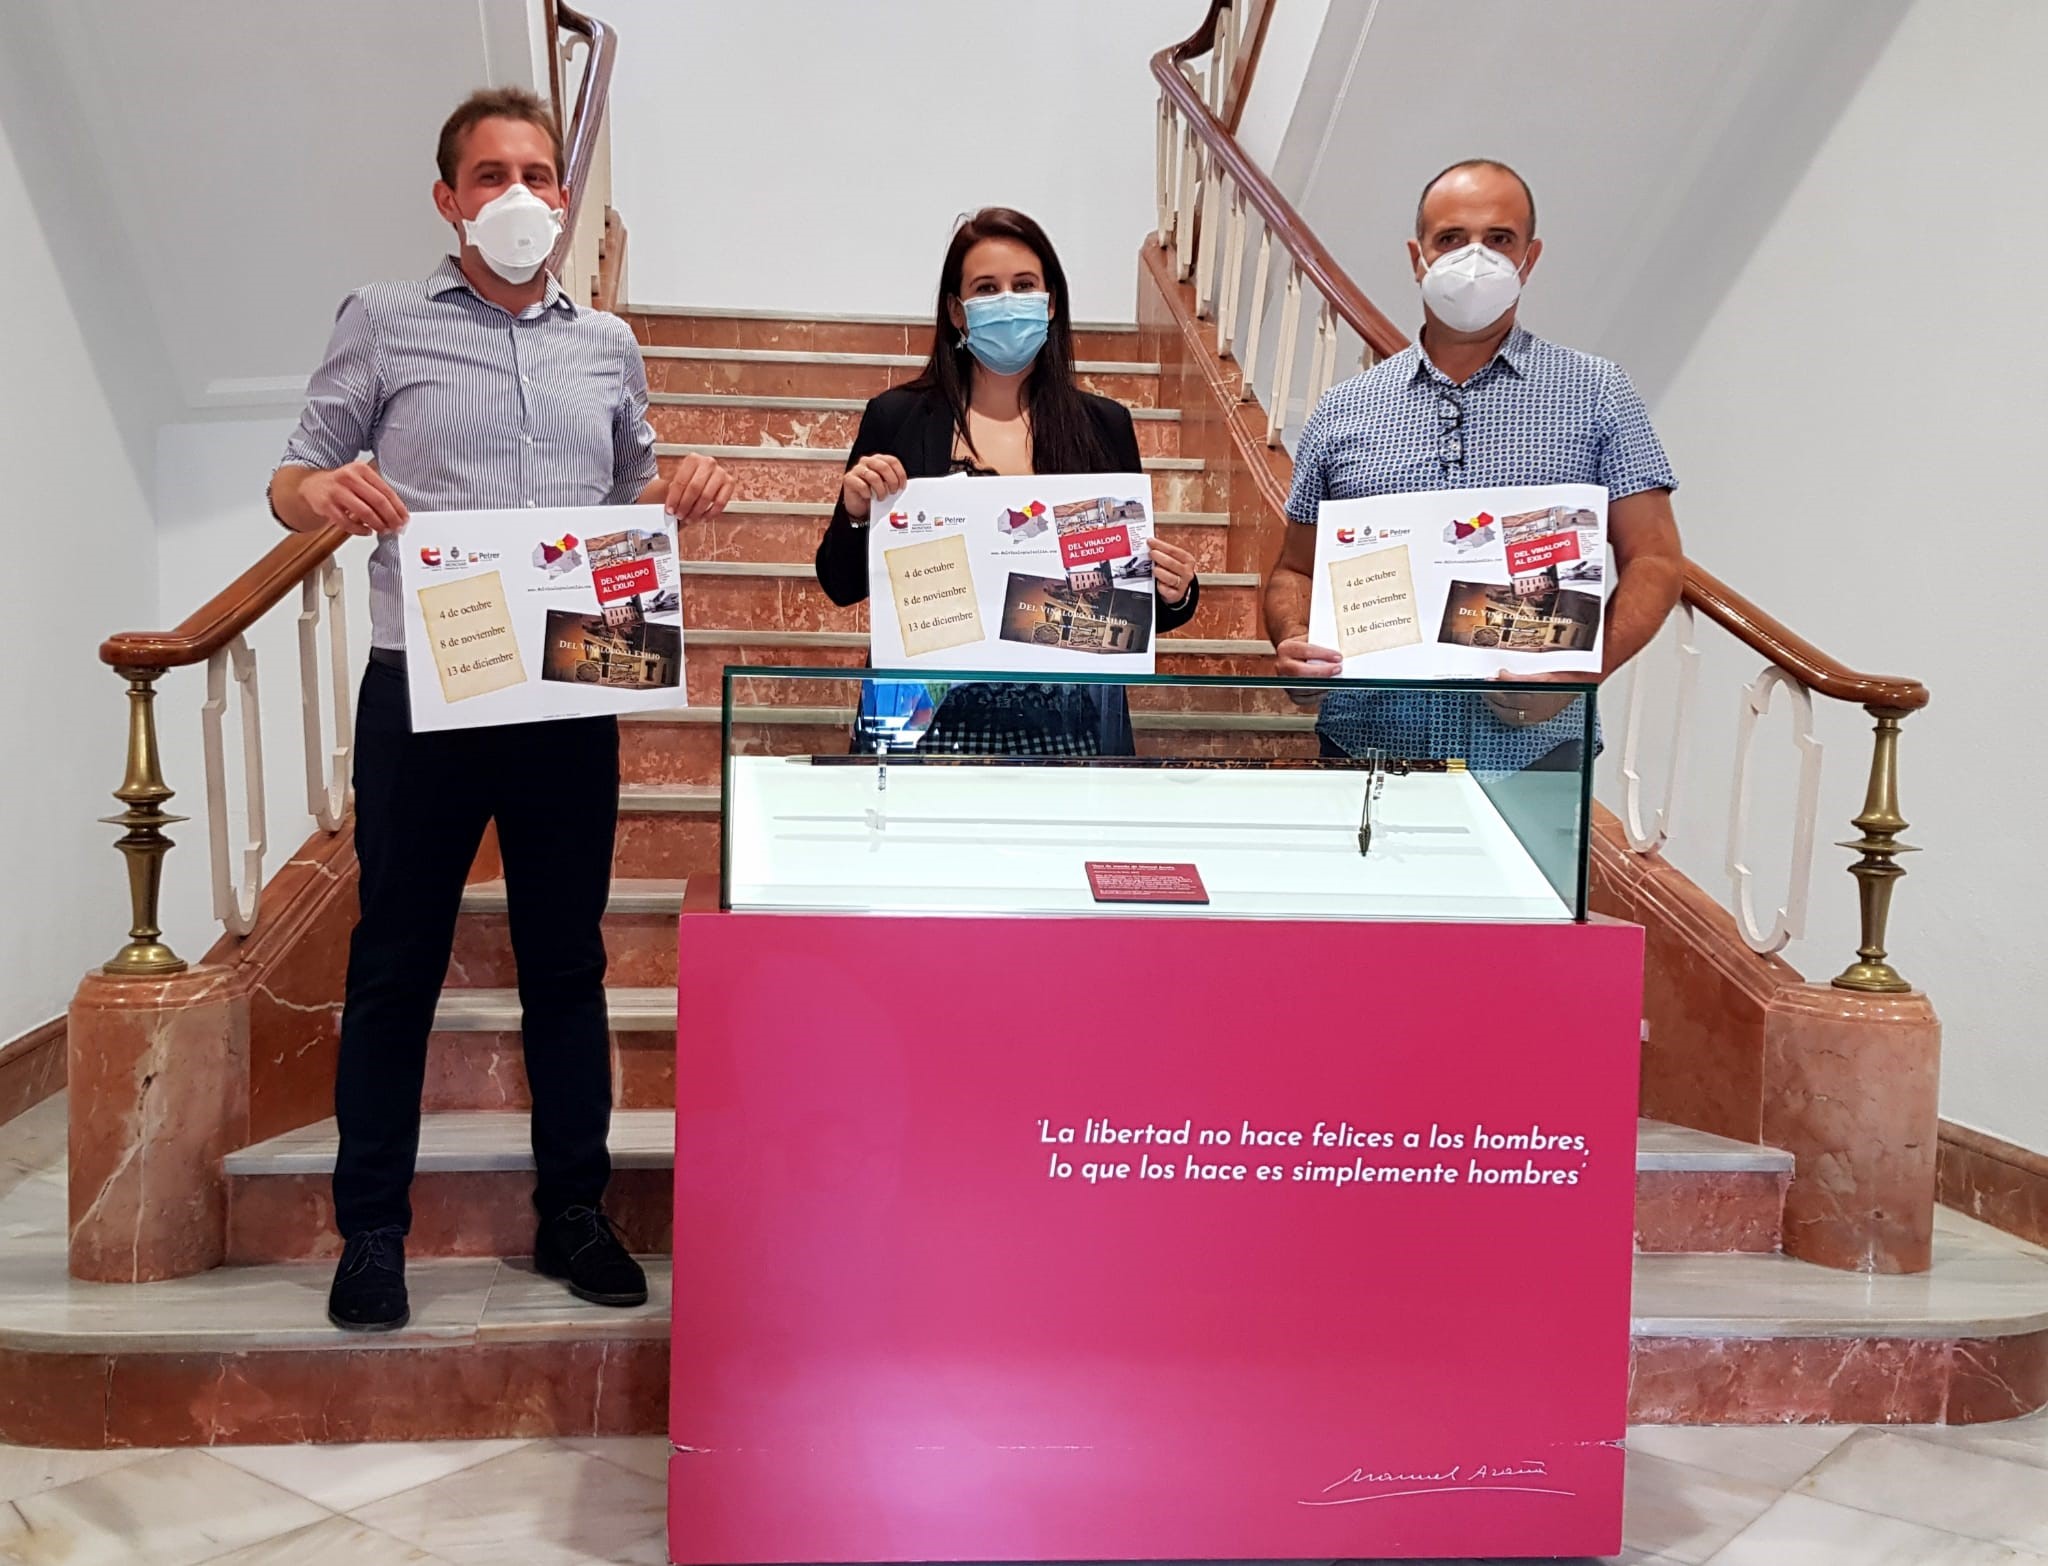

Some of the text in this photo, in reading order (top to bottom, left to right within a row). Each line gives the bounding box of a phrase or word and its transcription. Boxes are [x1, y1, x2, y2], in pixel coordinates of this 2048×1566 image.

[1067, 543, 1083, 551] DEL
[904, 562, 955, 579] 4 de octubre
[1353, 578, 1364, 586] de
[1365, 570, 1396, 583] octubre
[601, 577, 616, 585] DEL
[903, 586, 967, 606] 8 de noviembre
[1343, 592, 1407, 613] 8 de noviembre
[440, 601, 492, 619] 4 de octubre
[908, 611, 973, 632] 13 de diciembre
[1346, 616, 1412, 636] 13 de diciembre
[440, 626, 506, 649] 8 de noviembre
[447, 652, 514, 677] 13 de diciembre
[1085, 1118, 1191, 1145] libertad
[1199, 1128, 1231, 1146] no
[1240, 1121, 1303, 1146] hace
[1312, 1122, 1394, 1148] felices
[1403, 1131, 1420, 1148] a
[1429, 1124, 1464, 1149] los
[1474, 1125, 1589, 1156] hombres,
[1049, 1153, 1073, 1179] lo
[1081, 1161, 1131, 1184] que
[1139, 1154, 1176, 1179] los
[1185, 1155, 1247, 1180] hace
[1256, 1164, 1283, 1181] es
[1292, 1157, 1459, 1187] simplemente
